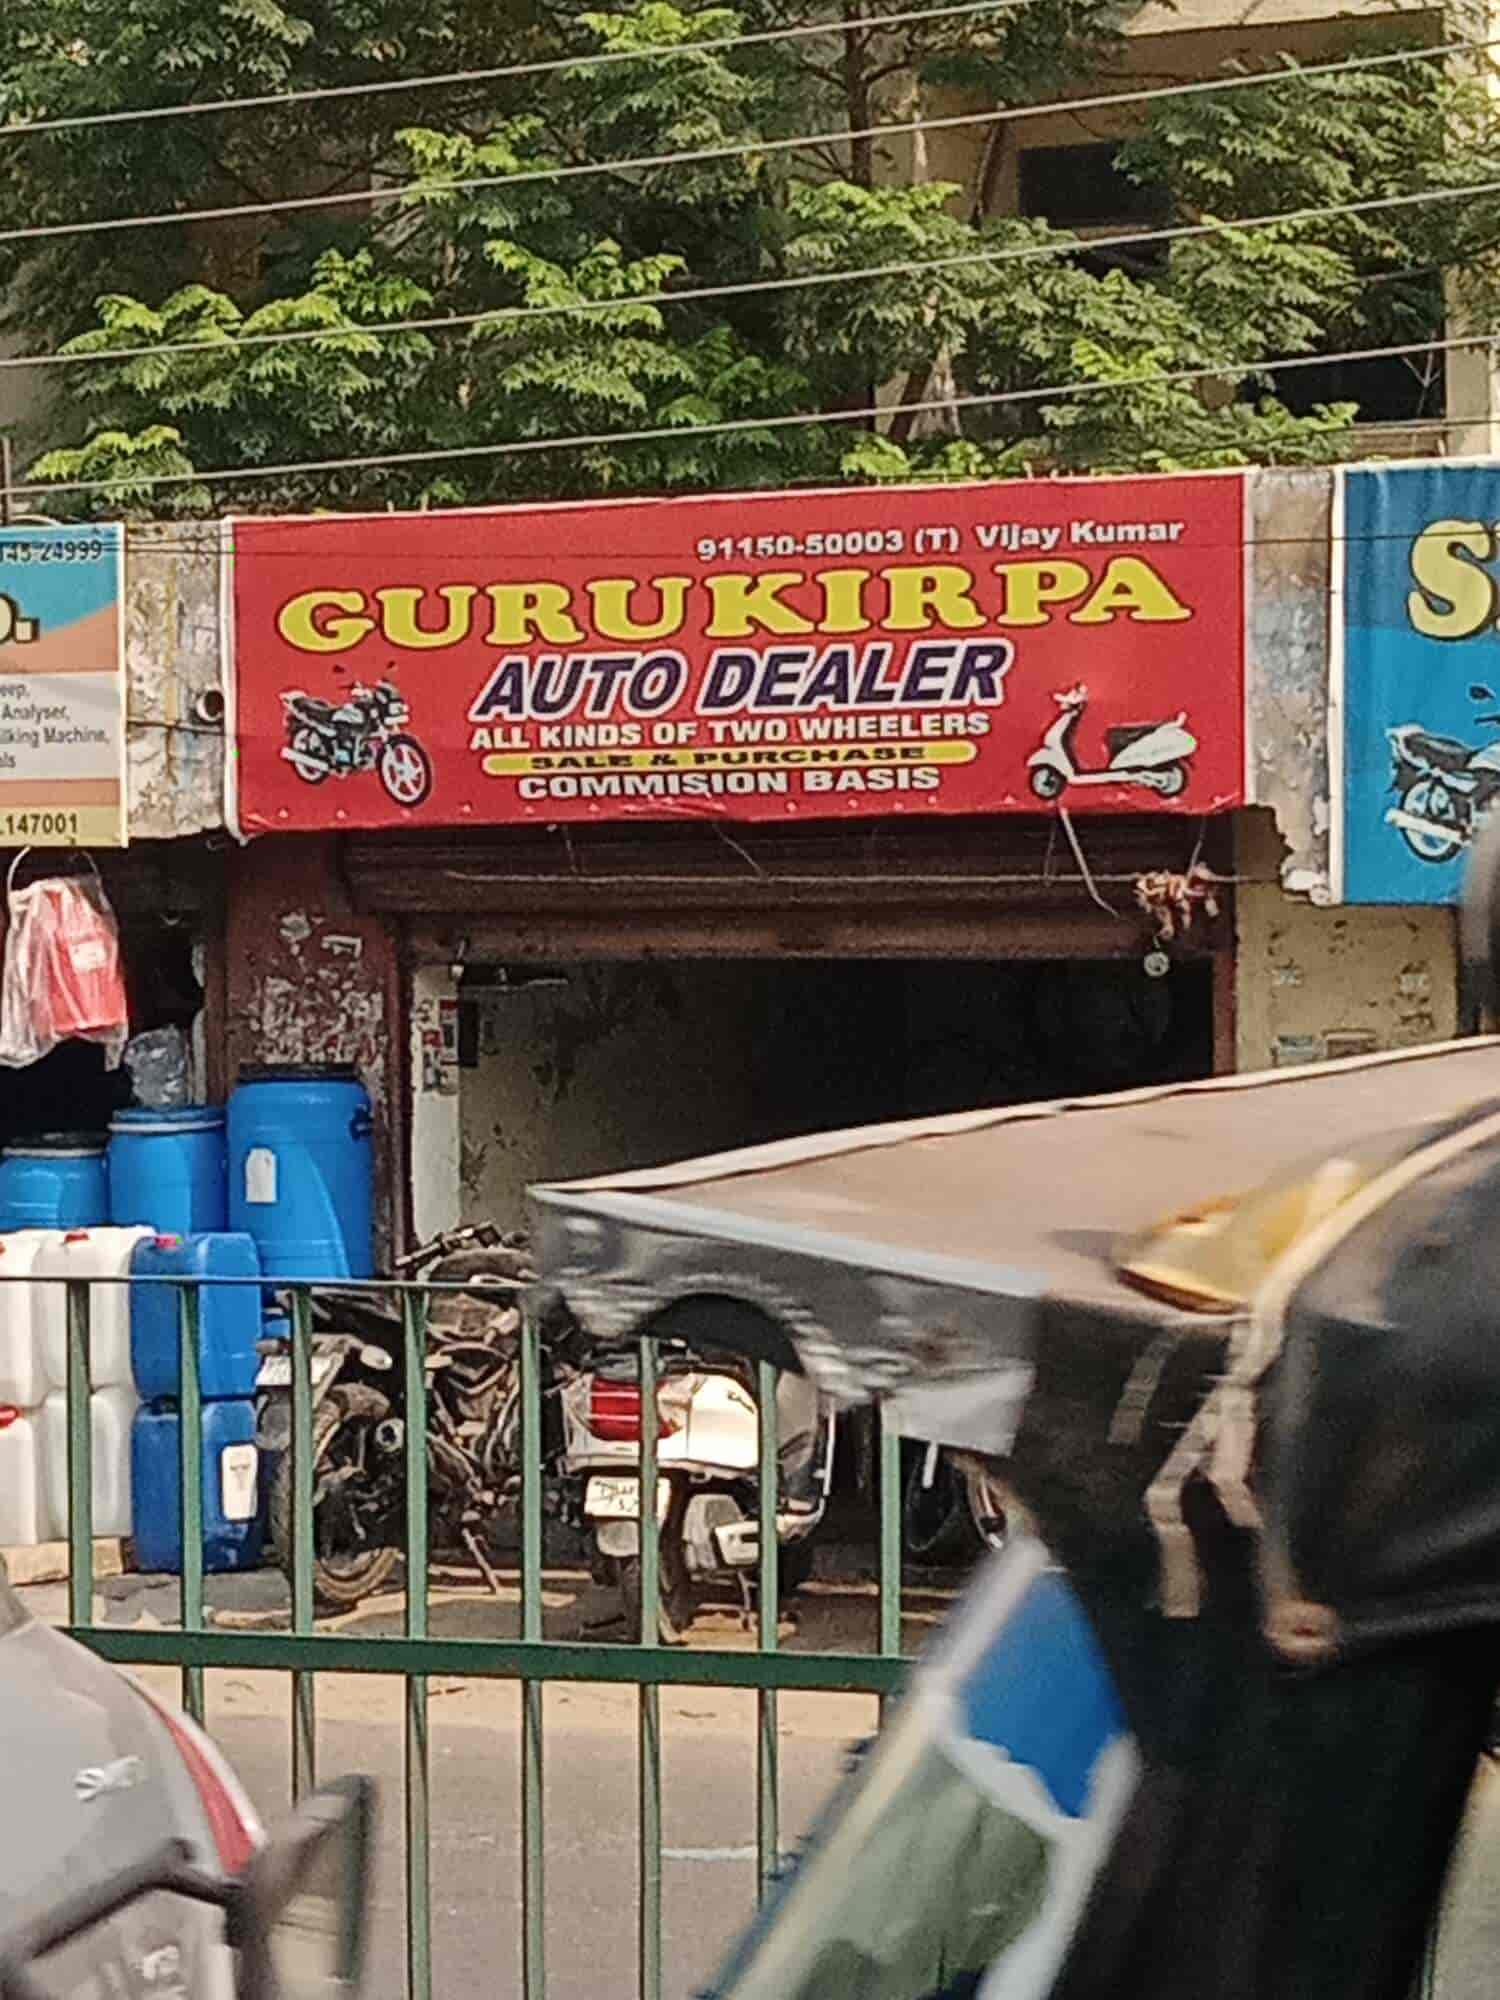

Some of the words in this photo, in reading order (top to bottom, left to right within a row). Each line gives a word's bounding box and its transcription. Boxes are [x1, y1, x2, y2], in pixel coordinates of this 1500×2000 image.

[696, 529, 904, 561] 91150-50003
[914, 527, 959, 554] (T)
[975, 523, 1061, 550] Vijay
[1070, 521, 1185, 544] Kumar
[1406, 517, 1500, 641] S
[276, 556, 1193, 652] GURUKIRPA
[468, 650, 688, 722] AUTO
[696, 638, 1014, 715] DEALER
[469, 727, 530, 752] ALL
[539, 722, 643, 748] KINDS
[652, 721, 698, 746] OF
[708, 719, 788, 744] TWO
[798, 712, 991, 741] WHEELERS
[530, 753, 634, 771] SALE
[649, 751, 679, 768] &
[693, 744, 926, 767] PURCHASE
[518, 771, 789, 800] COMMISION
[805, 767, 940, 793] BASIS
